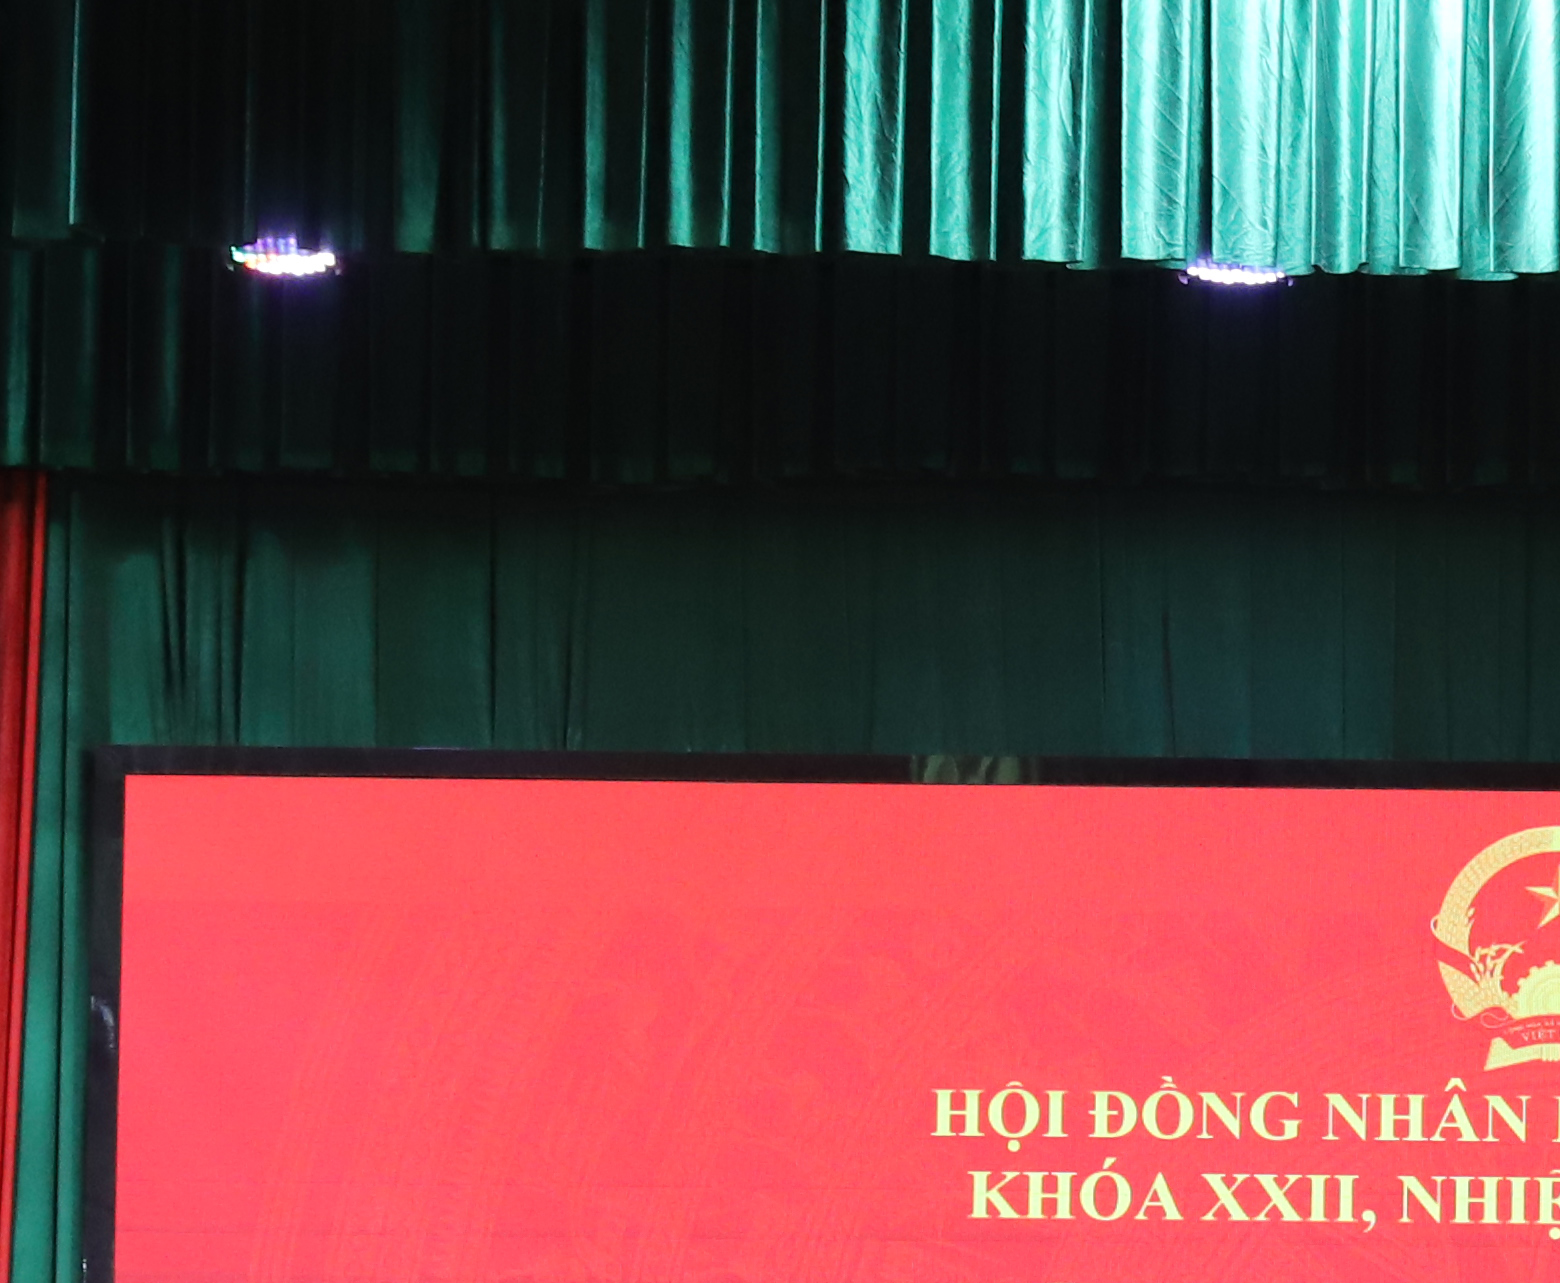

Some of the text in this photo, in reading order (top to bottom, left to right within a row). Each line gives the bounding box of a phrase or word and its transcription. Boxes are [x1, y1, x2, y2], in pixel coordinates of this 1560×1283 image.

[931, 1080, 1068, 1146] HỘI
[1088, 1075, 1301, 1142] ĐỒNG
[1322, 1077, 1531, 1143] NHÂN
[967, 1156, 1184, 1221] KHÓA
[1201, 1173, 1377, 1233] XXII,
